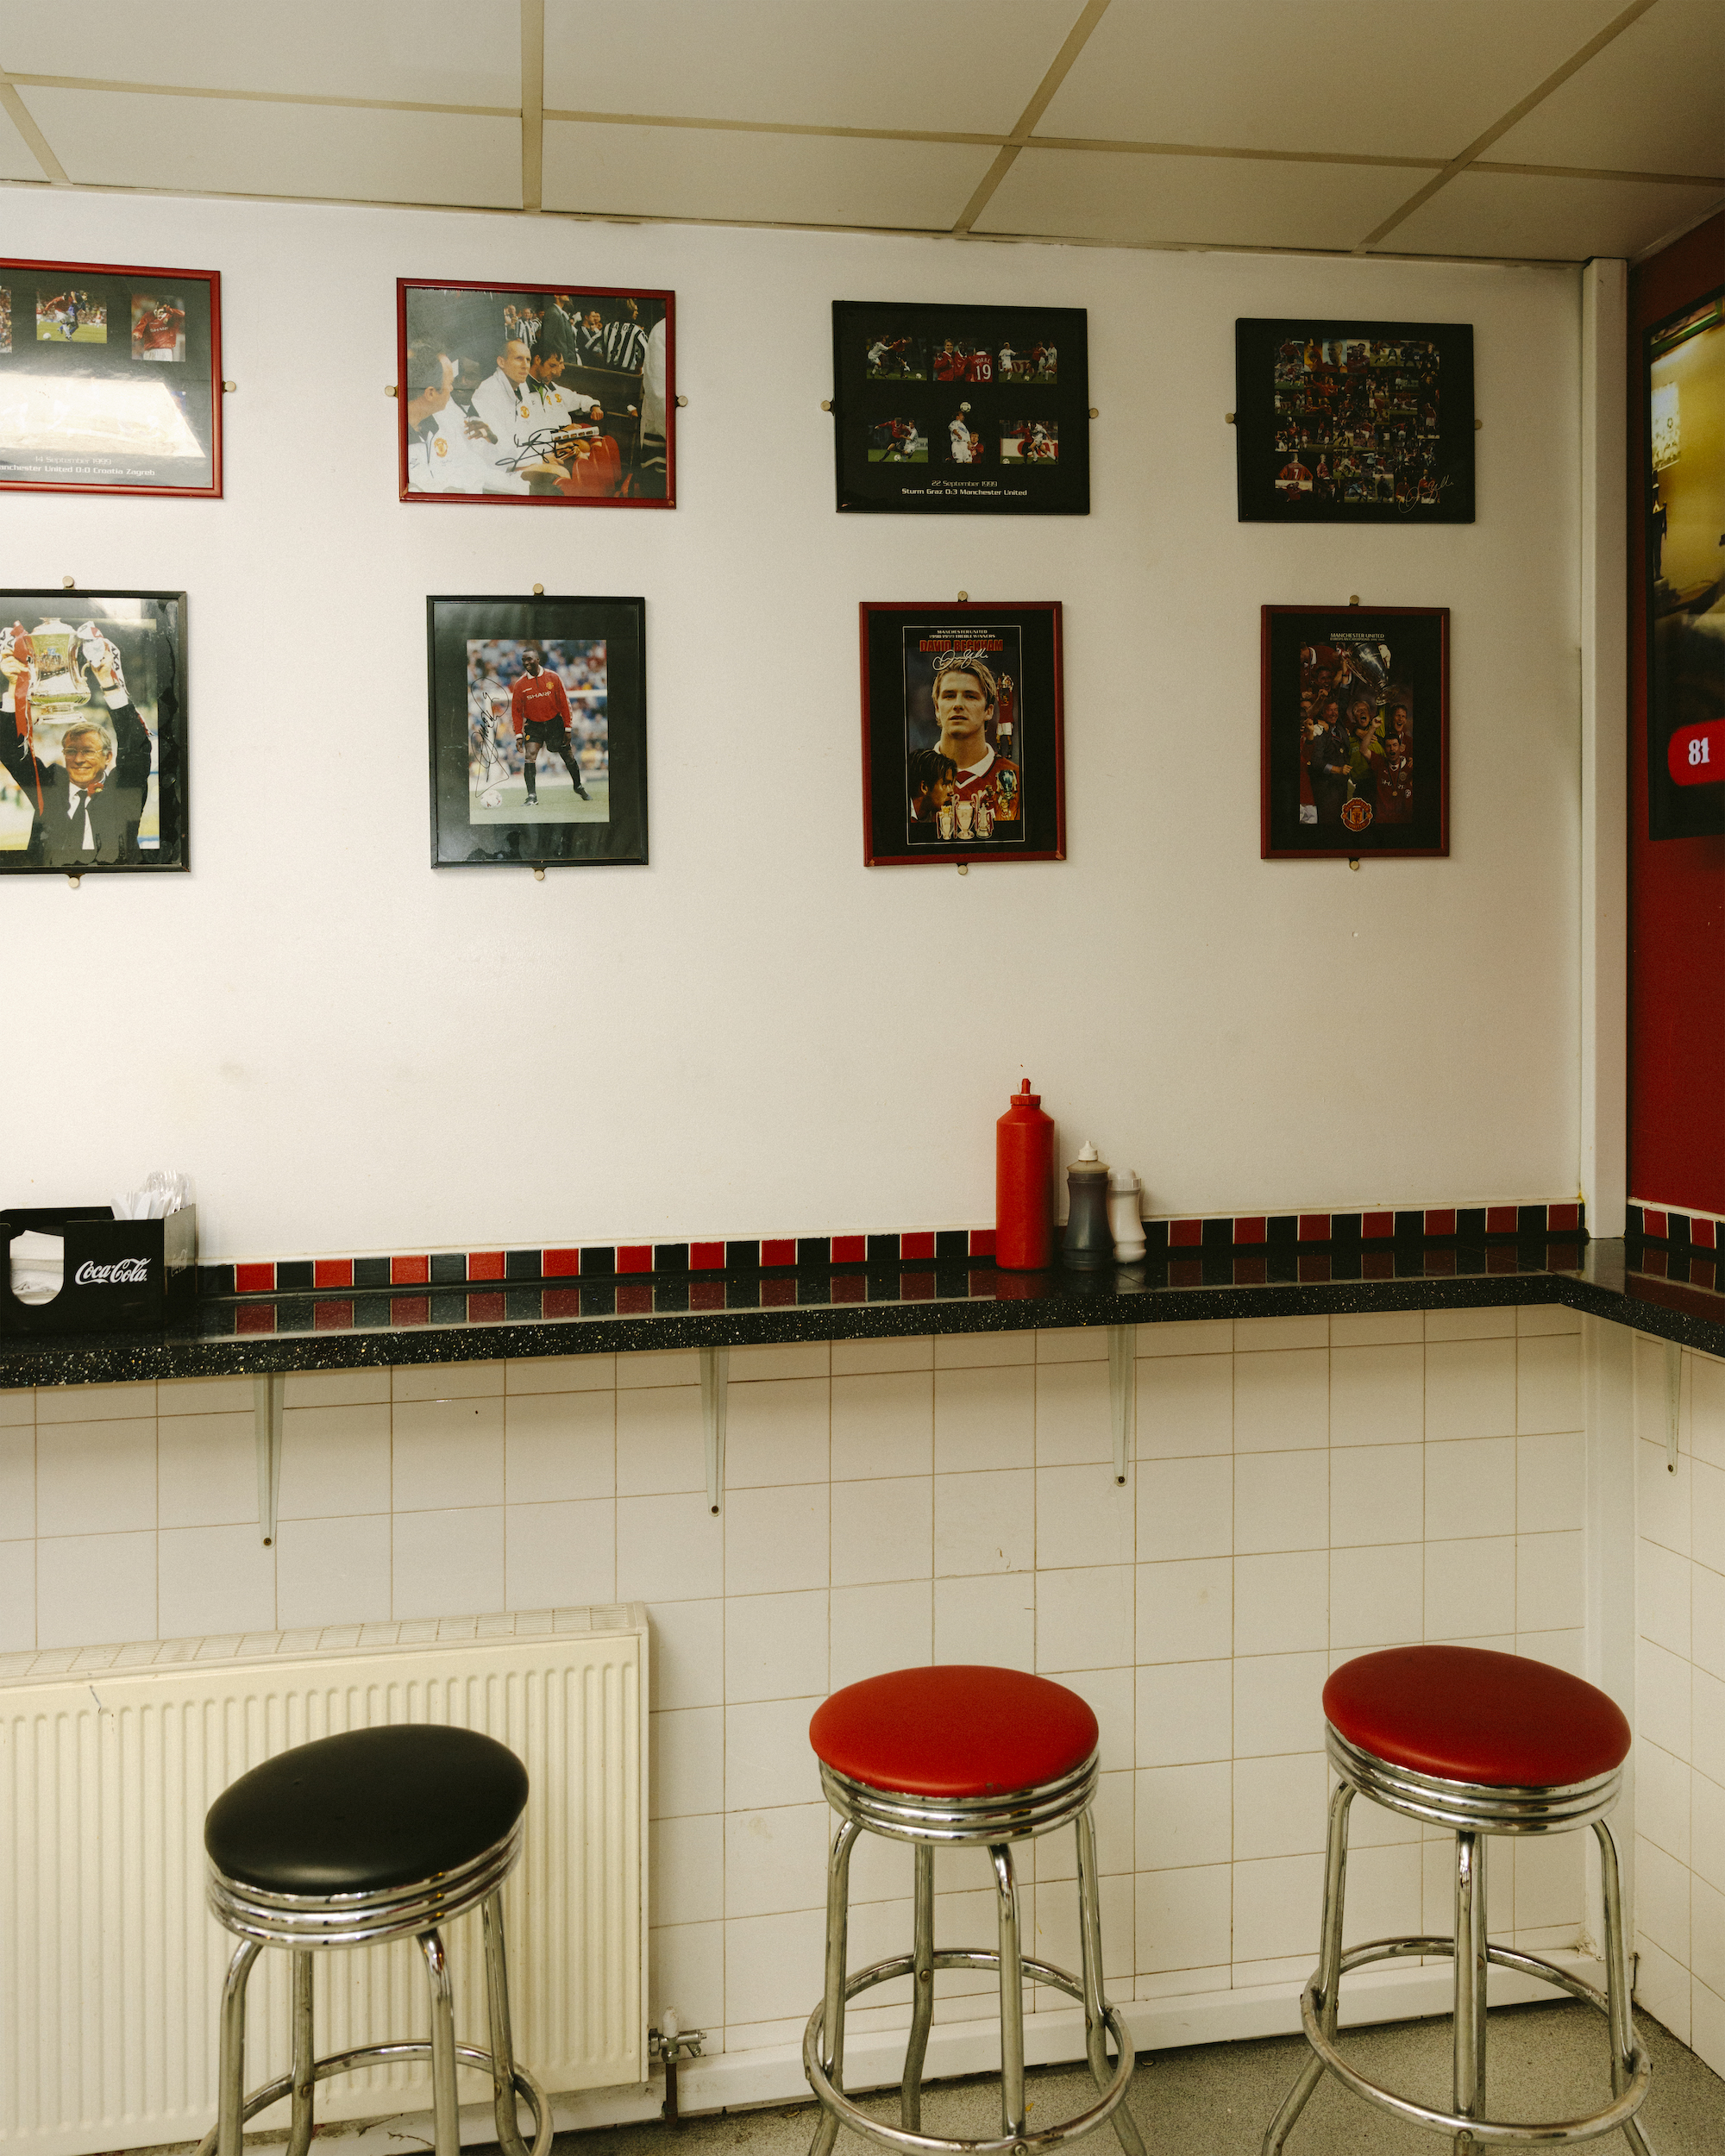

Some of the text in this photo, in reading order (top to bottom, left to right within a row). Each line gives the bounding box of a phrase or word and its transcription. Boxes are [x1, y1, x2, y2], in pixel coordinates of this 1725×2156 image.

[975, 363, 992, 380] 19
[1294, 468, 1299, 479] 7
[919, 639, 1004, 652] DAVID BECKHAM
[526, 690, 552, 700] SHARP
[1688, 736, 1710, 766] 81
[74, 1257, 153, 1286] Coca-Cola
